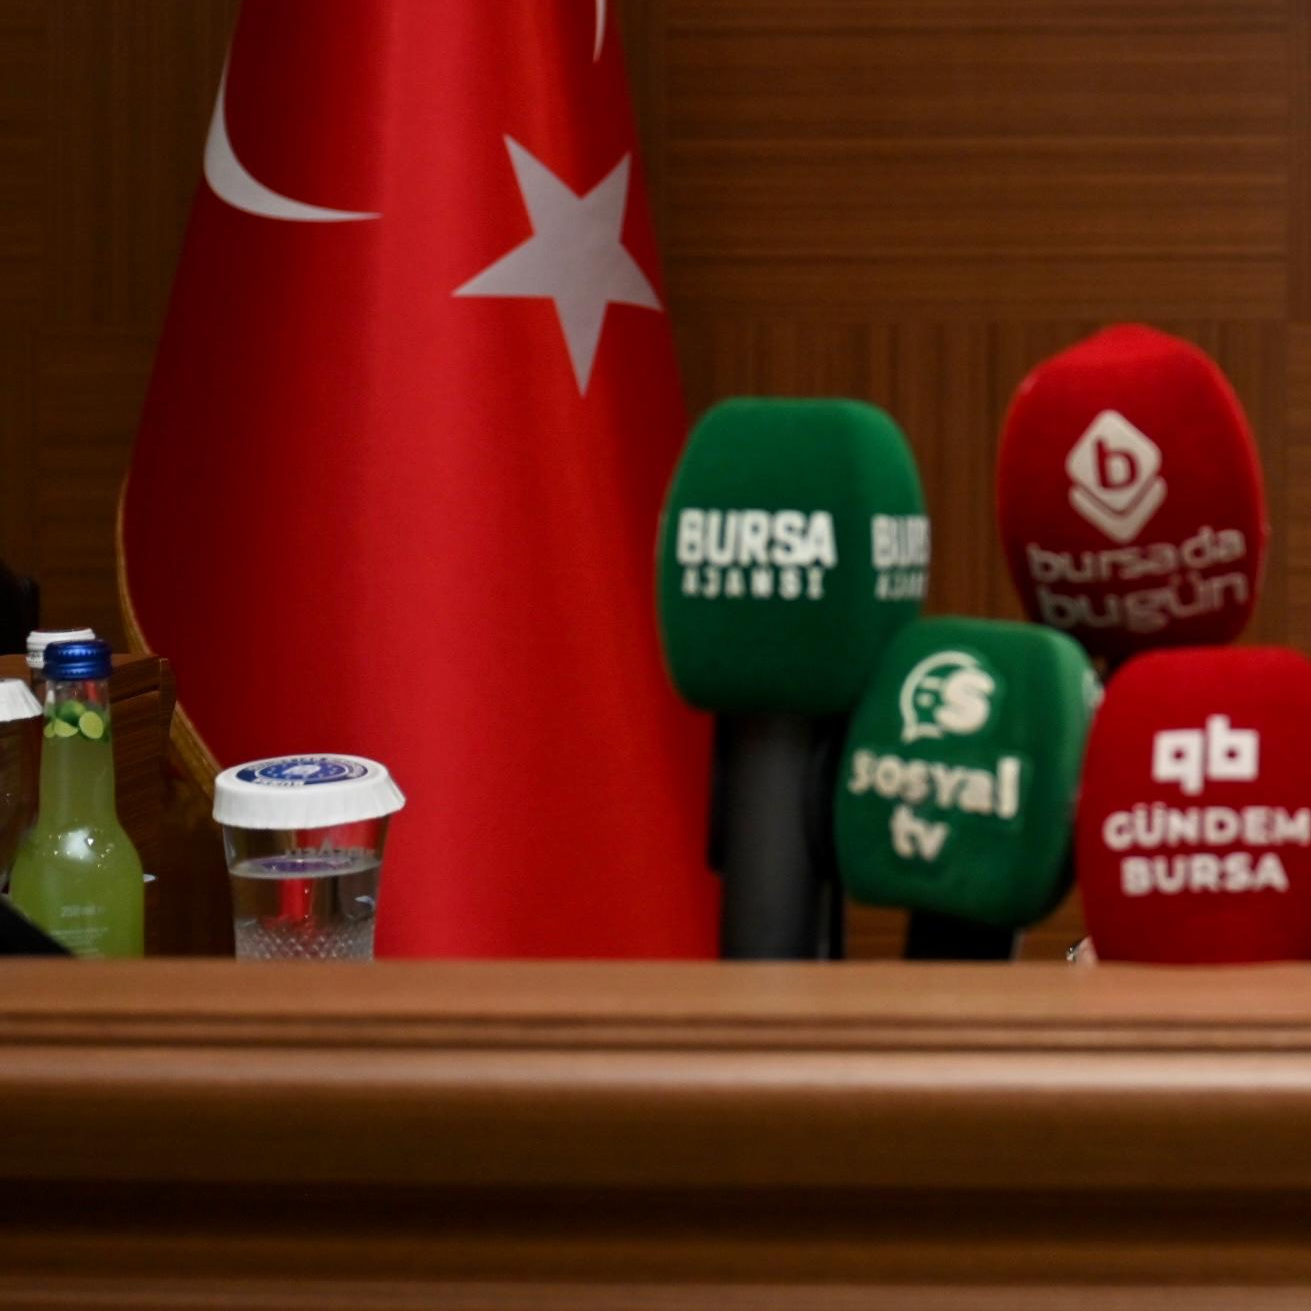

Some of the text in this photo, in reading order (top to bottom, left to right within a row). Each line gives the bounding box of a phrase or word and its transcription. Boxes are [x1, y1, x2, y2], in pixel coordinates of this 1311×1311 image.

[677, 508, 838, 570] BURSA
[1026, 525, 1247, 583] bursada
[682, 568, 824, 600] AJANSI
[1038, 571, 1249, 633] bugün
[848, 750, 1021, 819] sosyal
[890, 805, 949, 861] tv
[1120, 851, 1290, 897] BURSA
